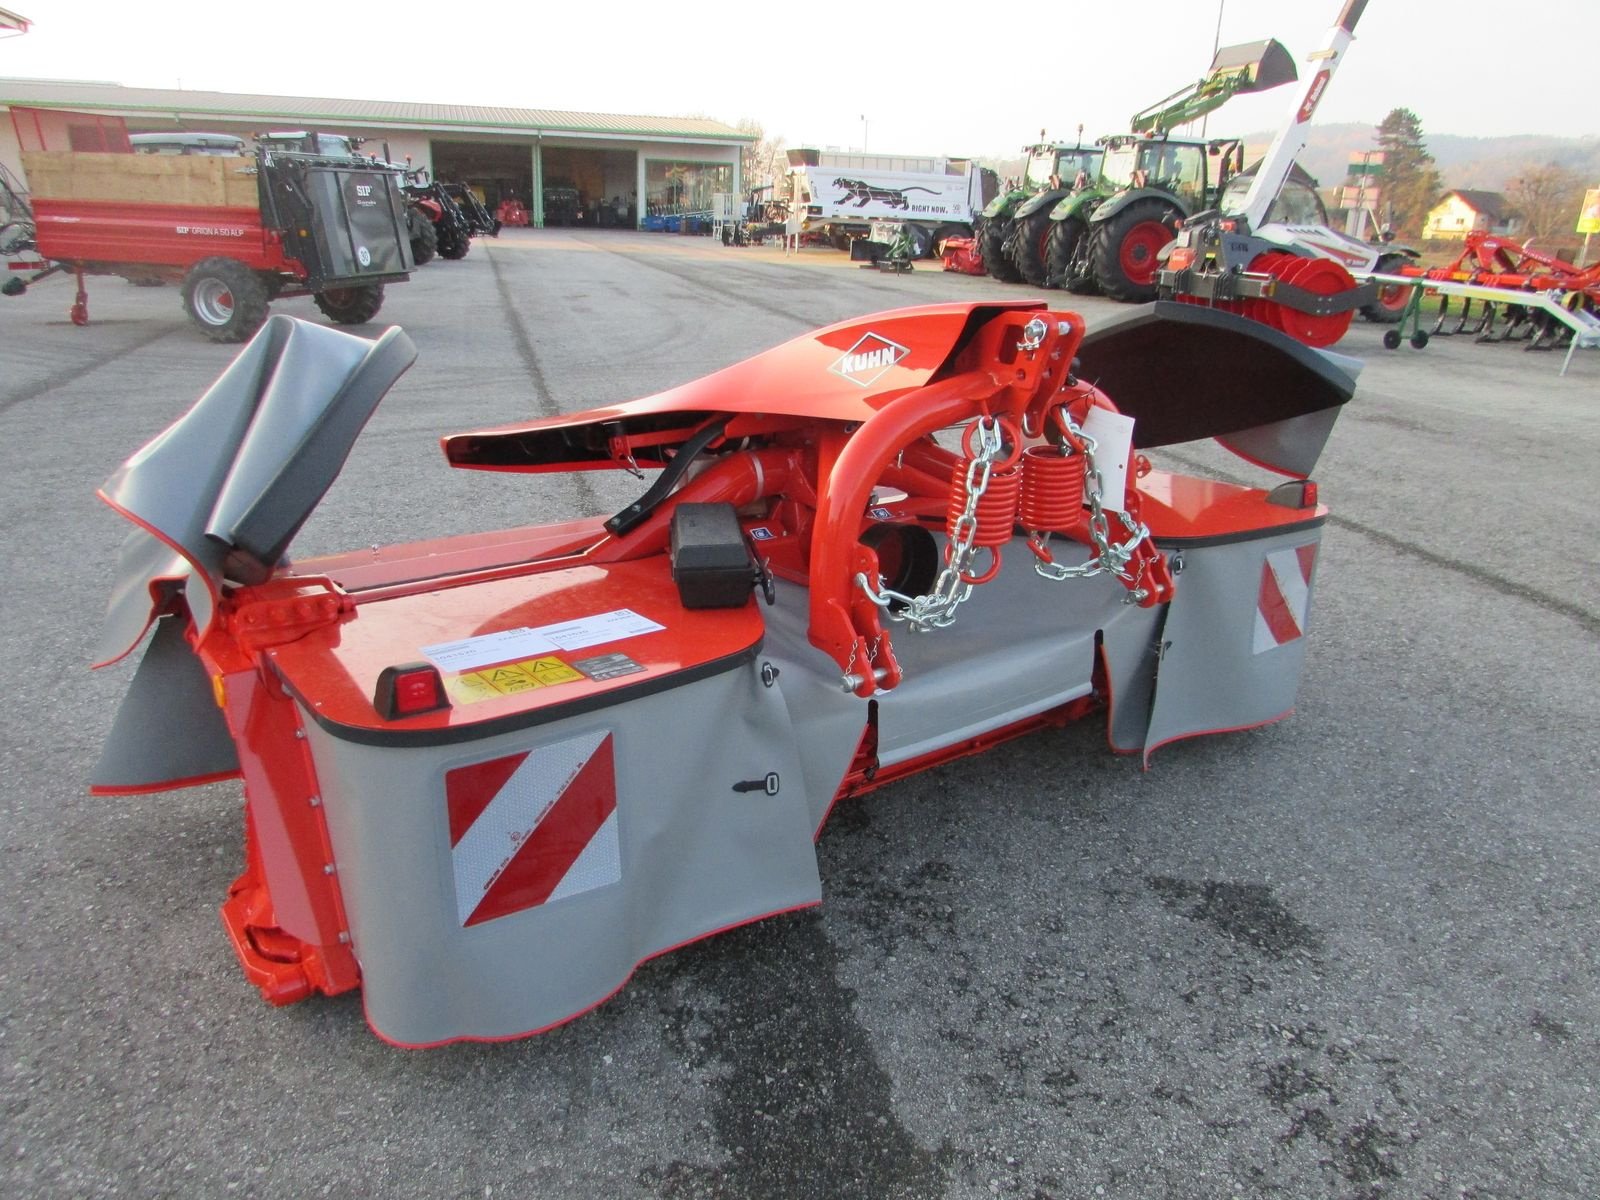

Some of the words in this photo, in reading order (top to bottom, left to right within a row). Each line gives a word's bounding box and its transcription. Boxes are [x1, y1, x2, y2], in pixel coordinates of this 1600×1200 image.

[356, 185, 371, 197] SIP
[911, 204, 930, 213] RIGHT
[931, 206, 949, 214] NOW.
[842, 346, 896, 374] KUHN
